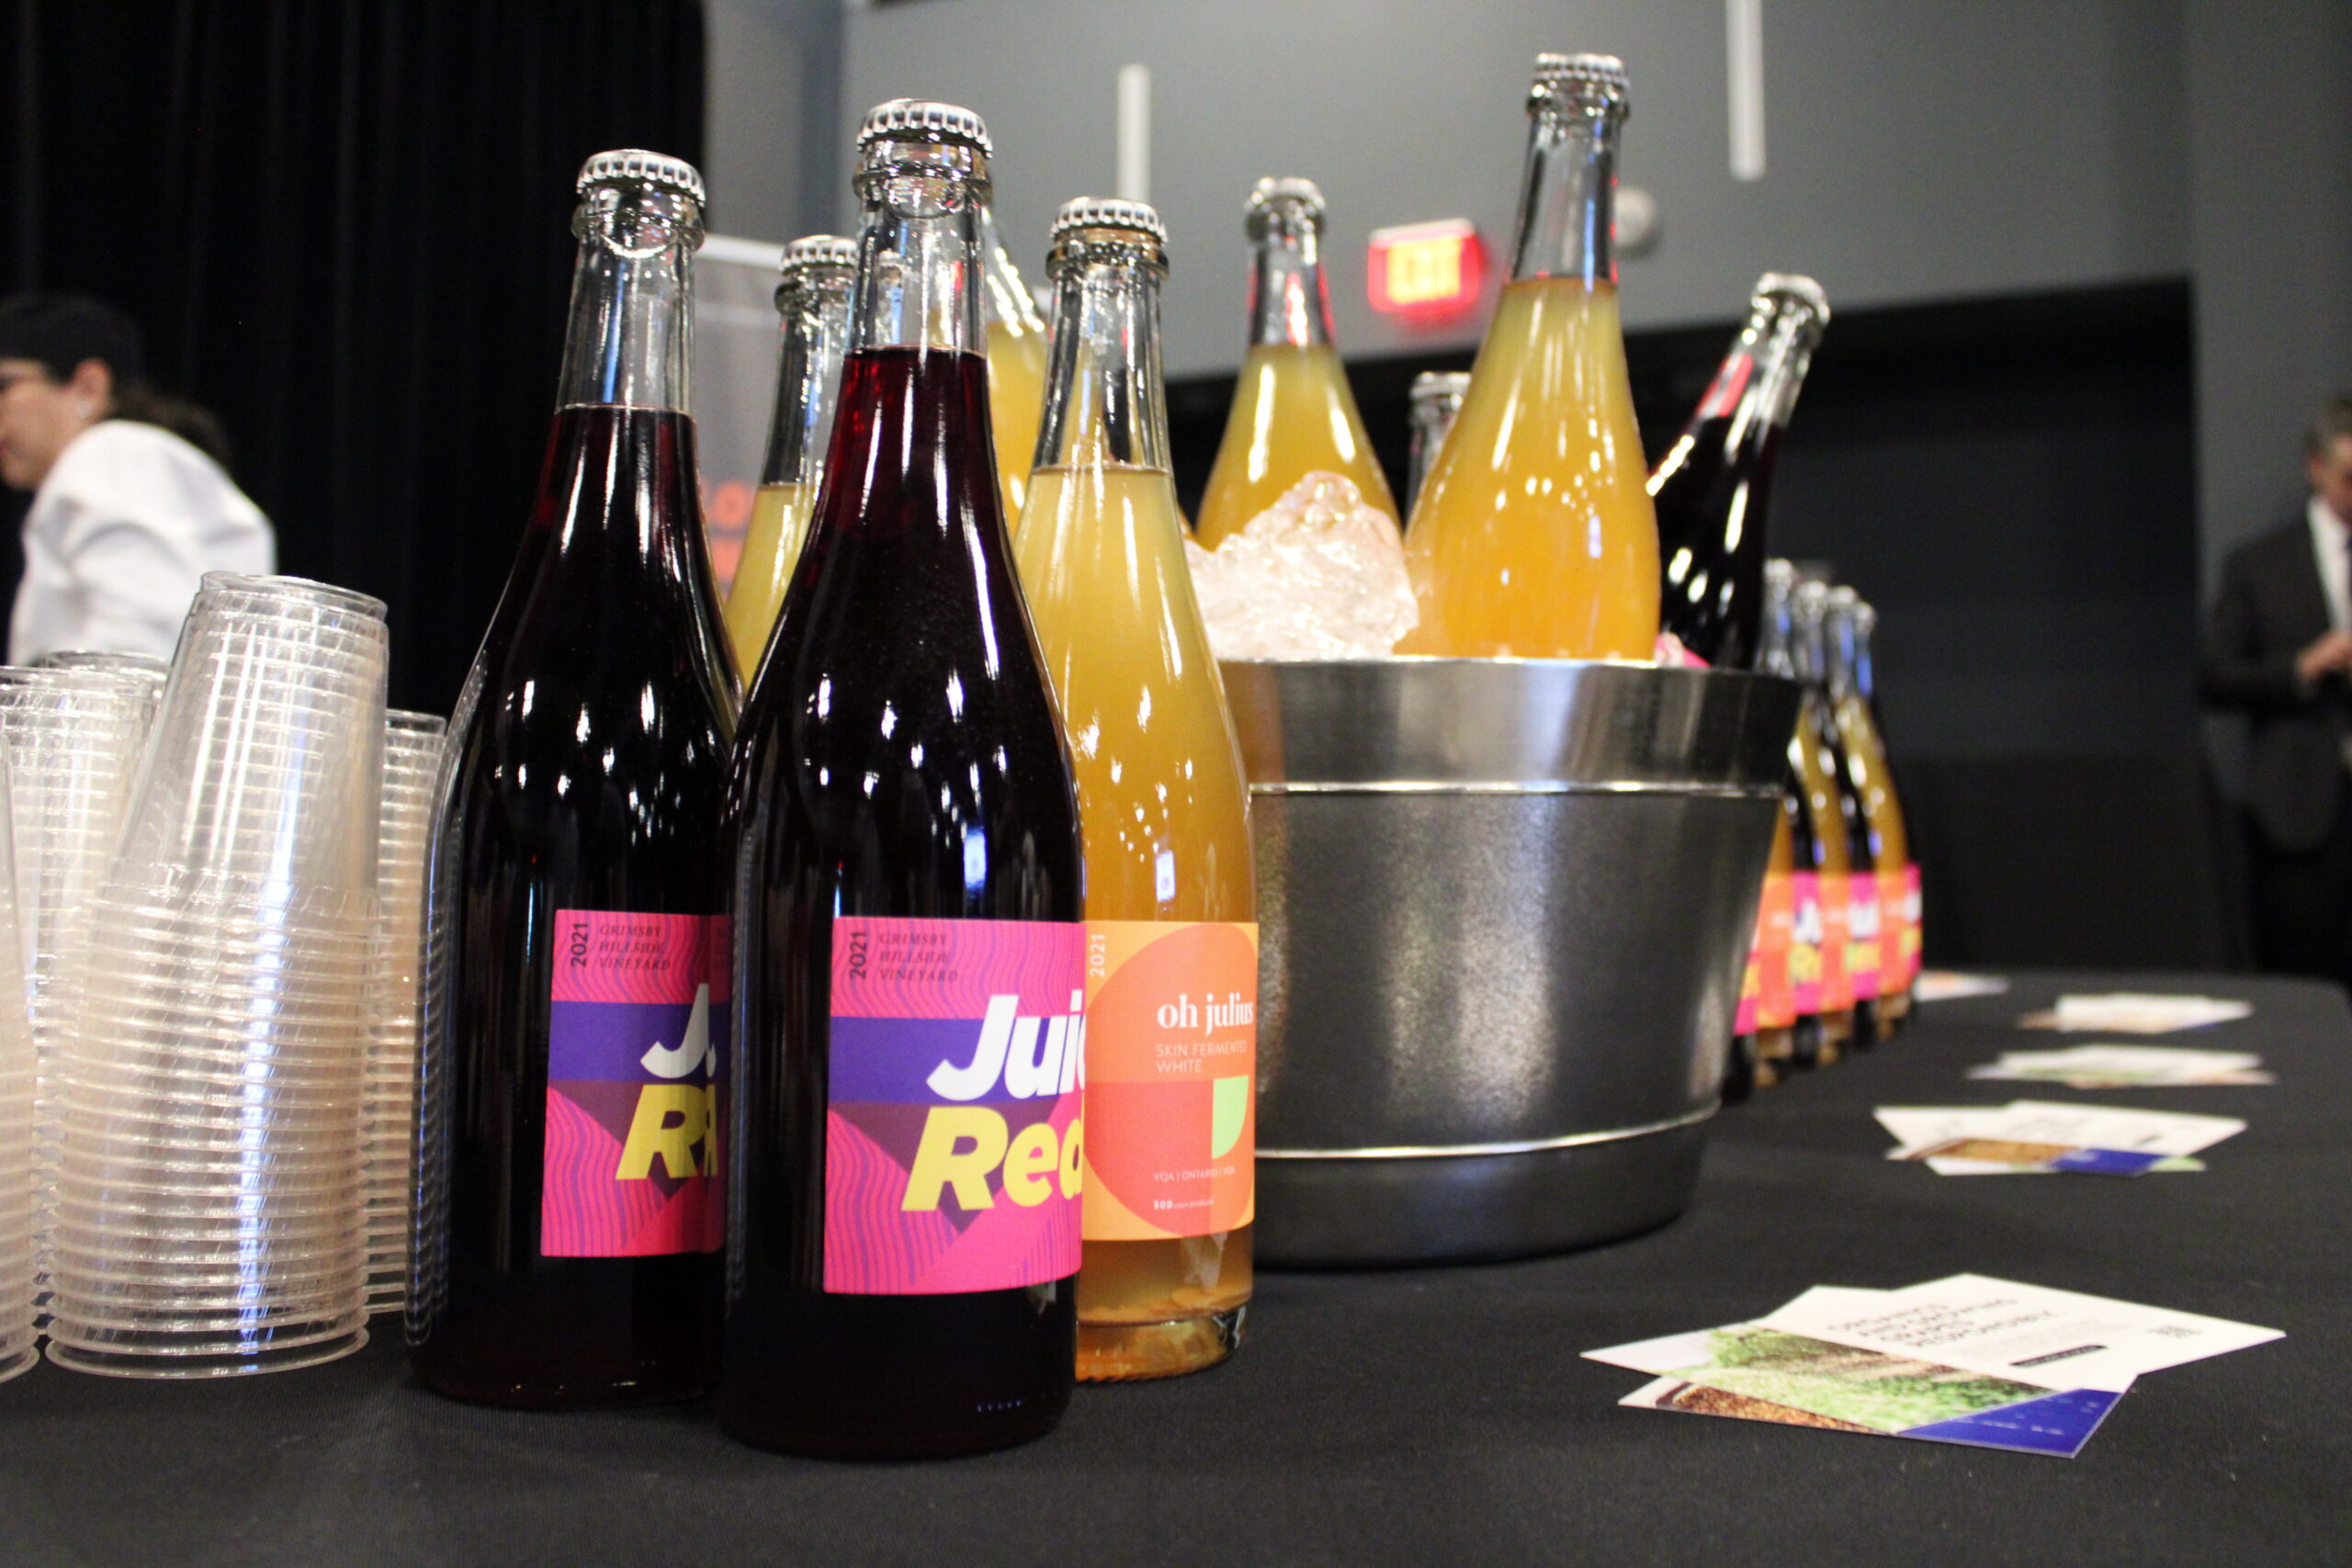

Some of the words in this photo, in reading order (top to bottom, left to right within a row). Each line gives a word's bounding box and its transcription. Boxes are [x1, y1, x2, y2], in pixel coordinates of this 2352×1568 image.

[600, 924, 663, 938] GRIMSBY
[879, 931, 947, 946] GRIMSBY
[571, 922, 589, 968] 2021
[599, 956, 672, 971] VINEYARD
[849, 931, 867, 980] 2021
[1089, 934, 1105, 978] 2021
[880, 967, 958, 983] VINEYARD
[1157, 993, 1198, 1029] oh
[1204, 991, 1254, 1037] julius
[926, 989, 1086, 1100] Jui
[1155, 1042, 1189, 1058] SKIN
[1155, 1058, 1203, 1074] WHITE
[1153, 1170, 1175, 1182] VQA
[1181, 1168, 1219, 1181] ONTARIO
